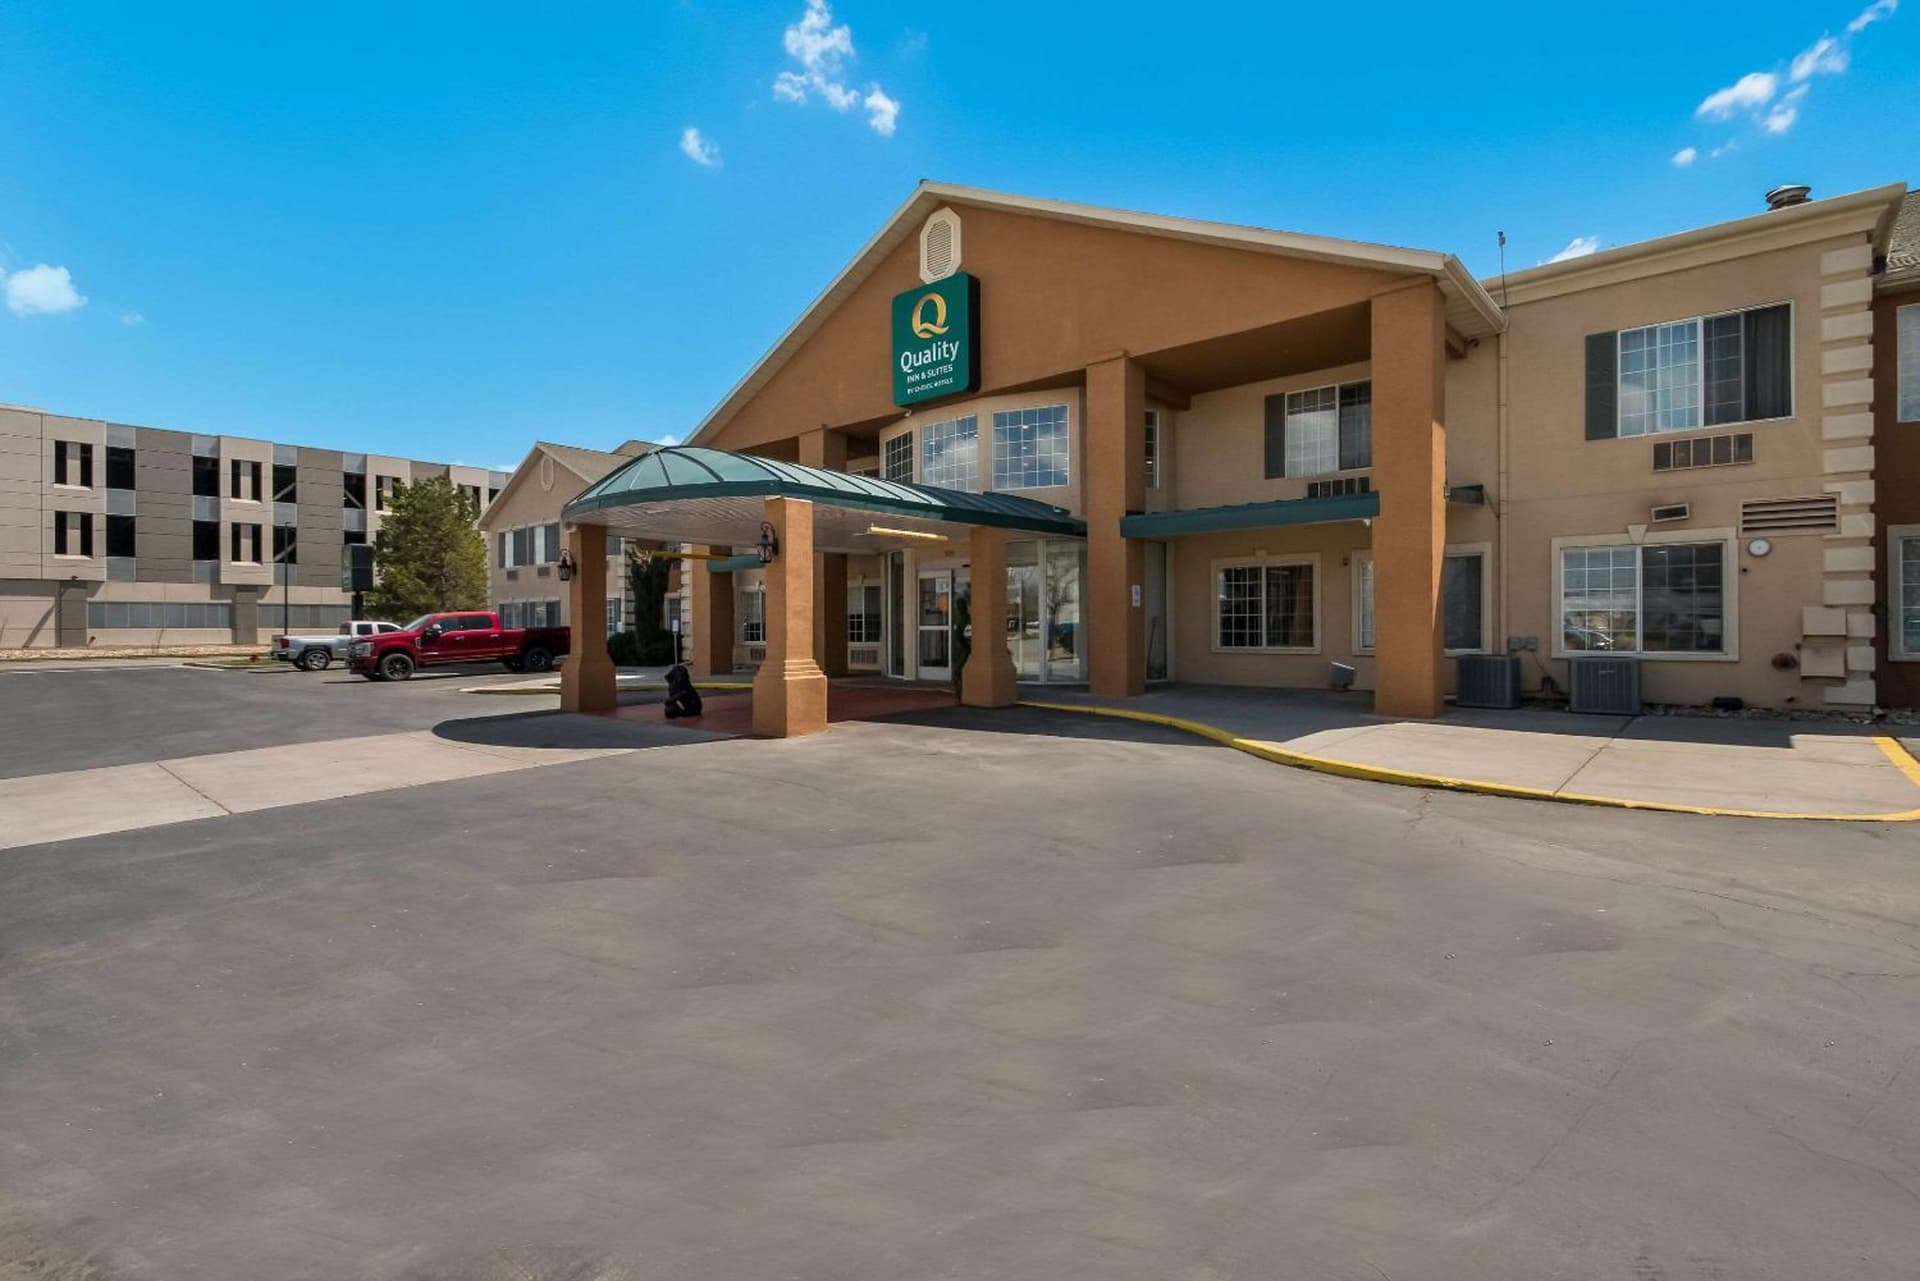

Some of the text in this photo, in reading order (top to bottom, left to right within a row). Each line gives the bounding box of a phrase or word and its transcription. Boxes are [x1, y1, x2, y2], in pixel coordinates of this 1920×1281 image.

[912, 293, 949, 339] Q
[901, 341, 959, 373] Quality
[907, 364, 953, 384] INN & SUITES
